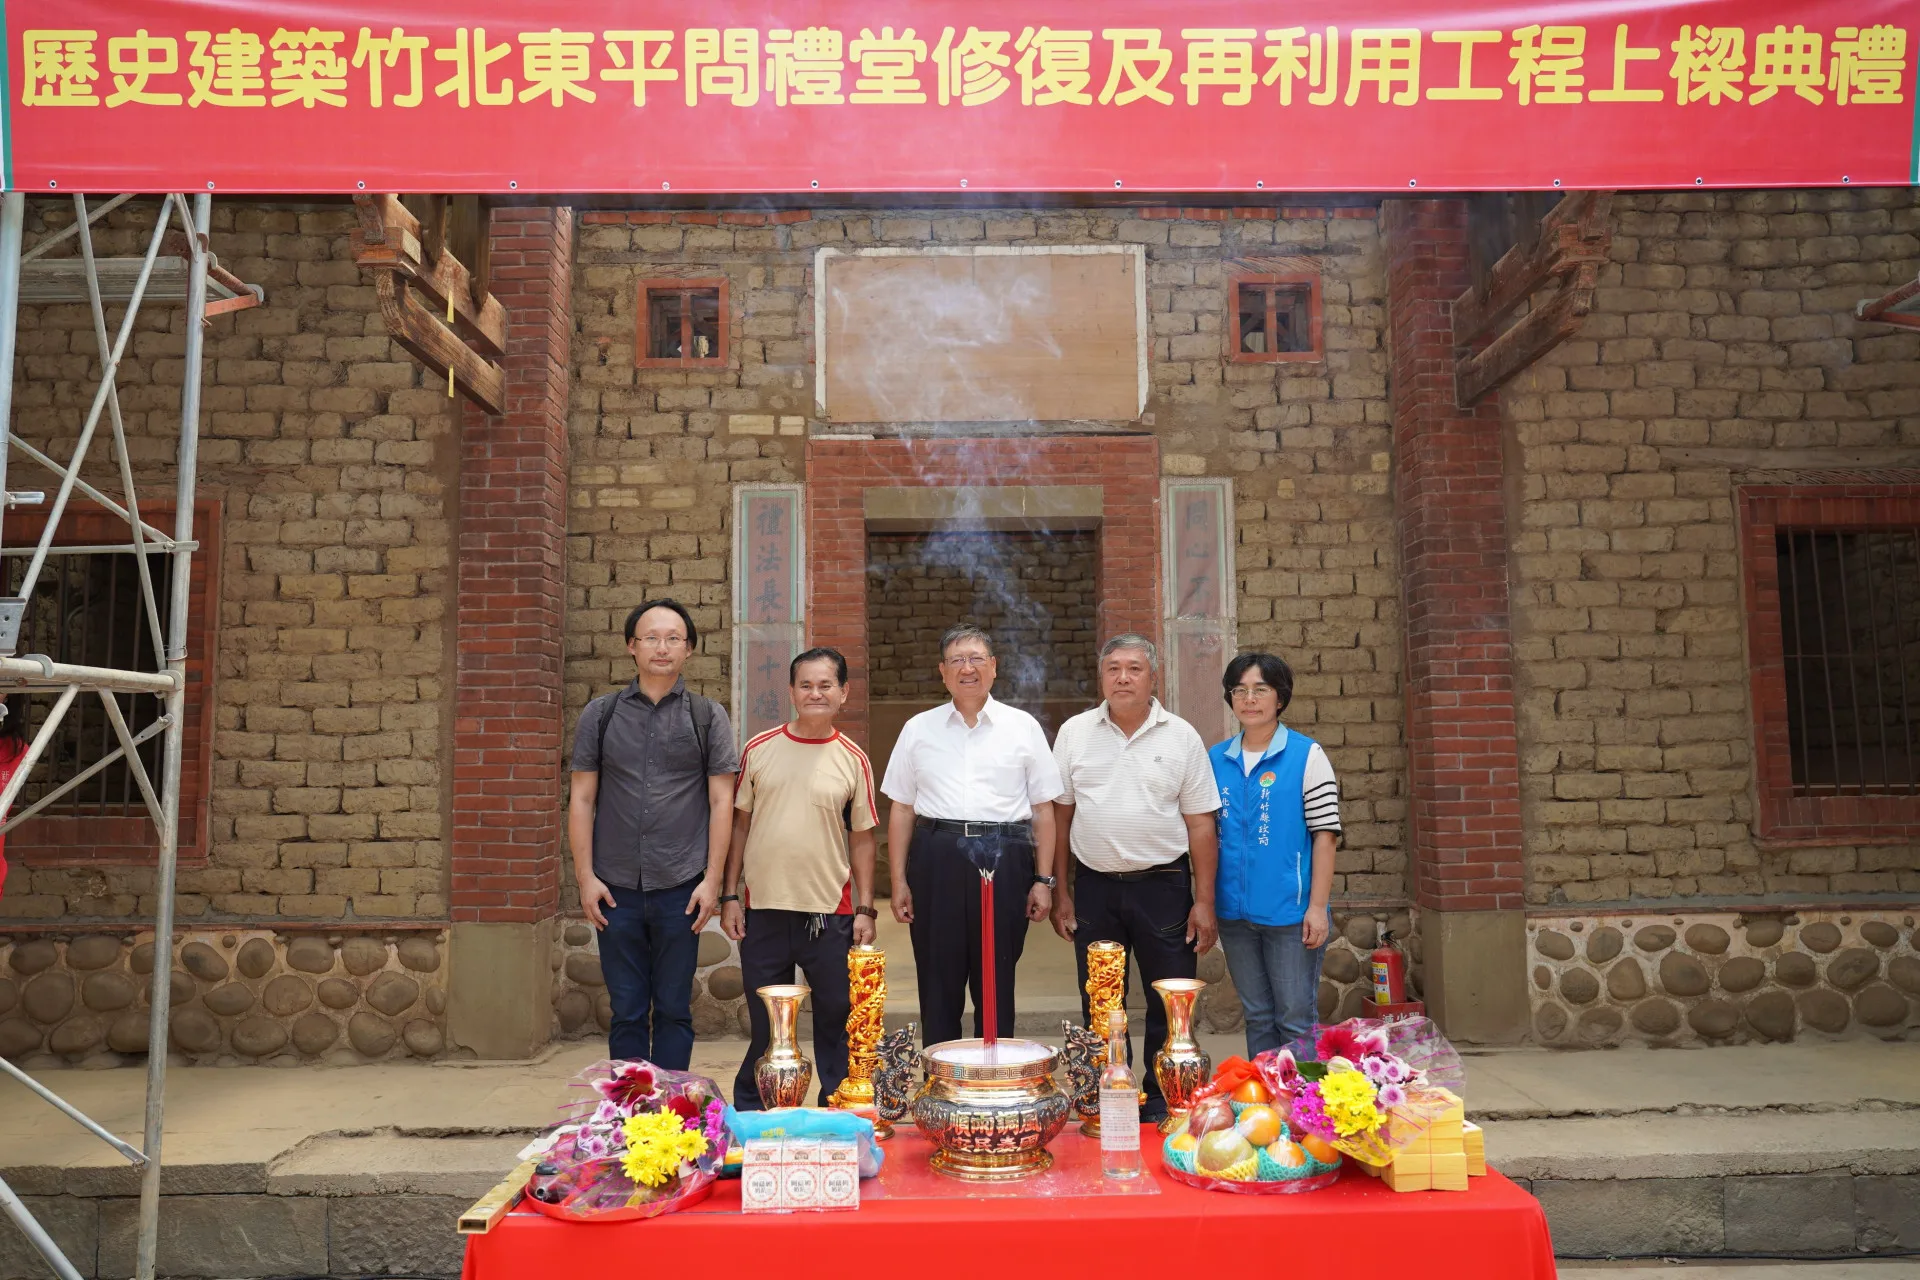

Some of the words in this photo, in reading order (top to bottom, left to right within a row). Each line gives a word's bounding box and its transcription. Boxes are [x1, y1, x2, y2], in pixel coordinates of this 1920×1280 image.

[22, 24, 1907, 107] 歷史建築竹北東平問禮堂修復及再利用工程上樑典禮
[1221, 786, 1230, 818] 文化局
[1258, 788, 1271, 846] 新竹縣政府
